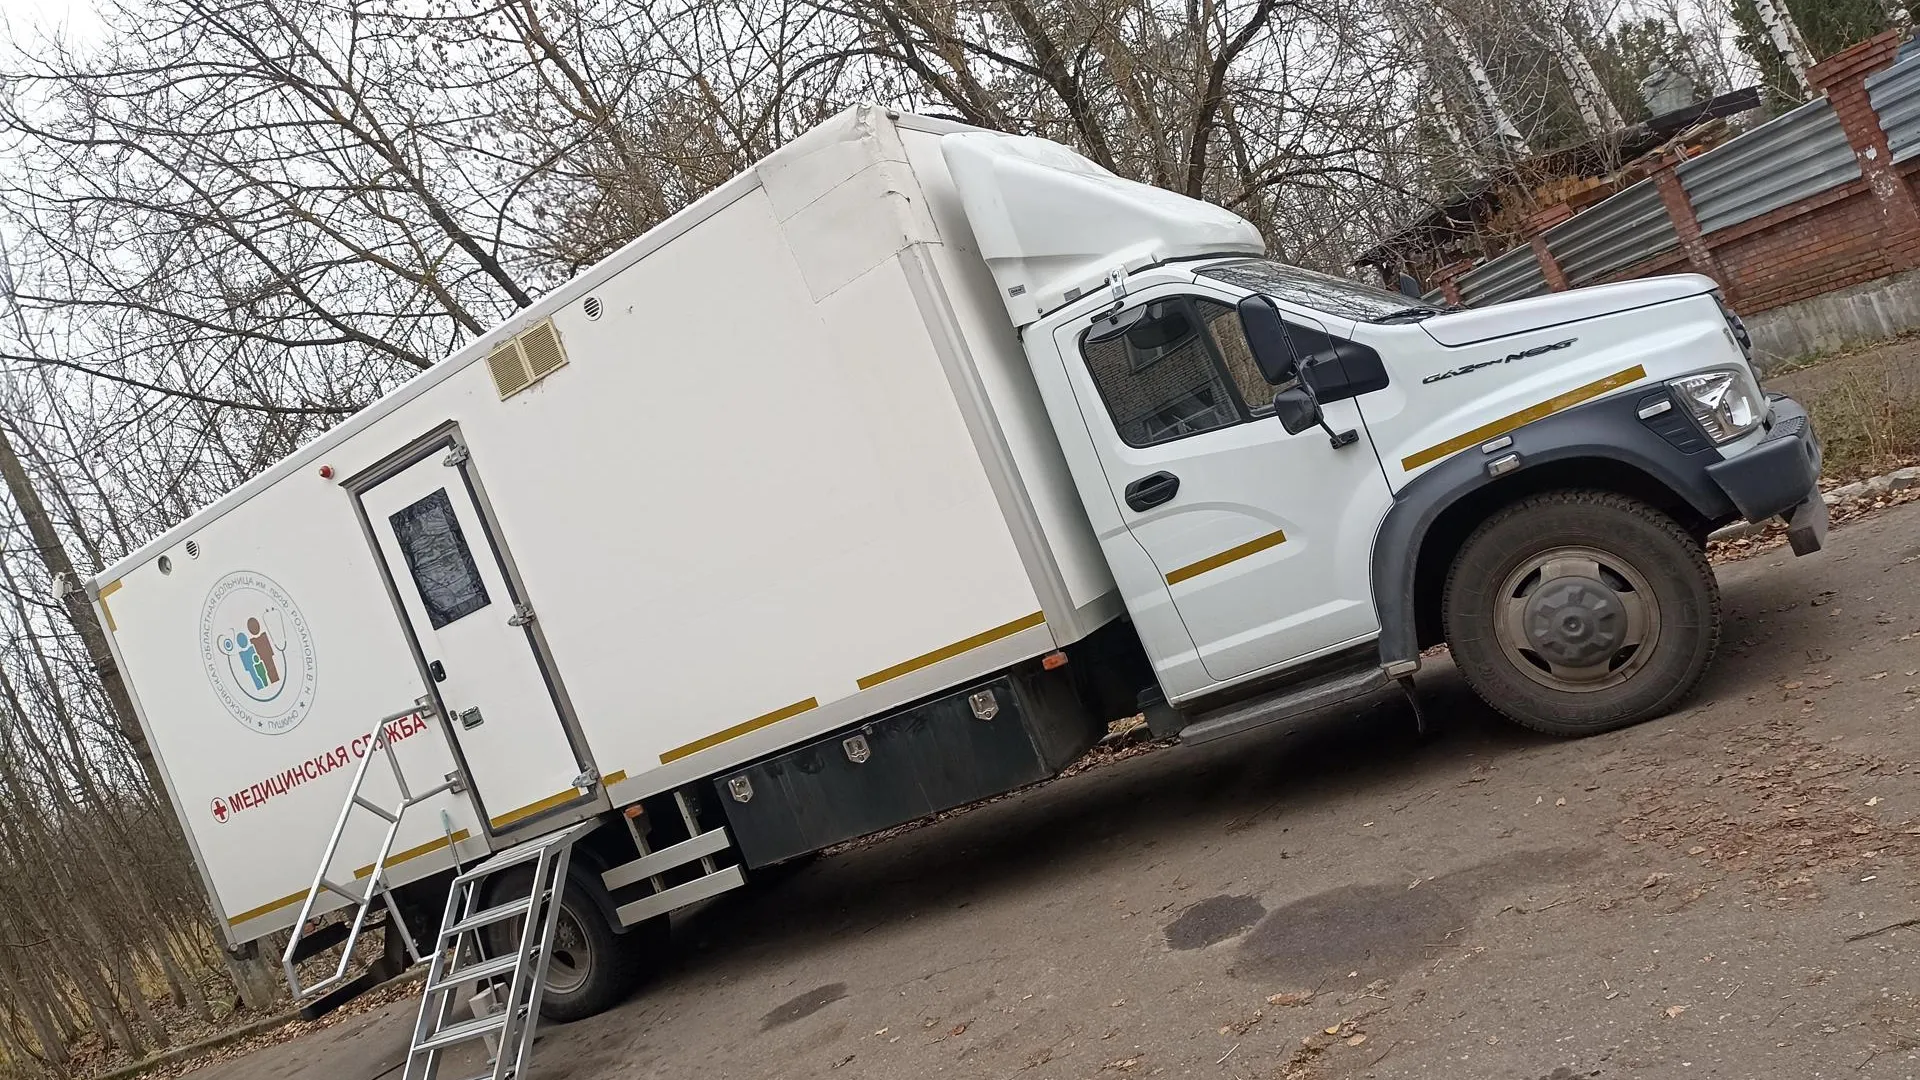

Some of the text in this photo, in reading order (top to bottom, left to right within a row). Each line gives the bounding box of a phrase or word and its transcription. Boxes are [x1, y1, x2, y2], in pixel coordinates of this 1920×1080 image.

[214, 576, 254, 600] БОЛЬНИЦА
[203, 598, 216, 661] ОБЛАСТНАЯ
[291, 610, 313, 671] РОЗАНОВА
[209, 663, 253, 724] МОСКОВСКАЯ
[267, 709, 299, 729] ПУШКИНО
[228, 745, 351, 814] МЕДИЦИНСКАЯ
